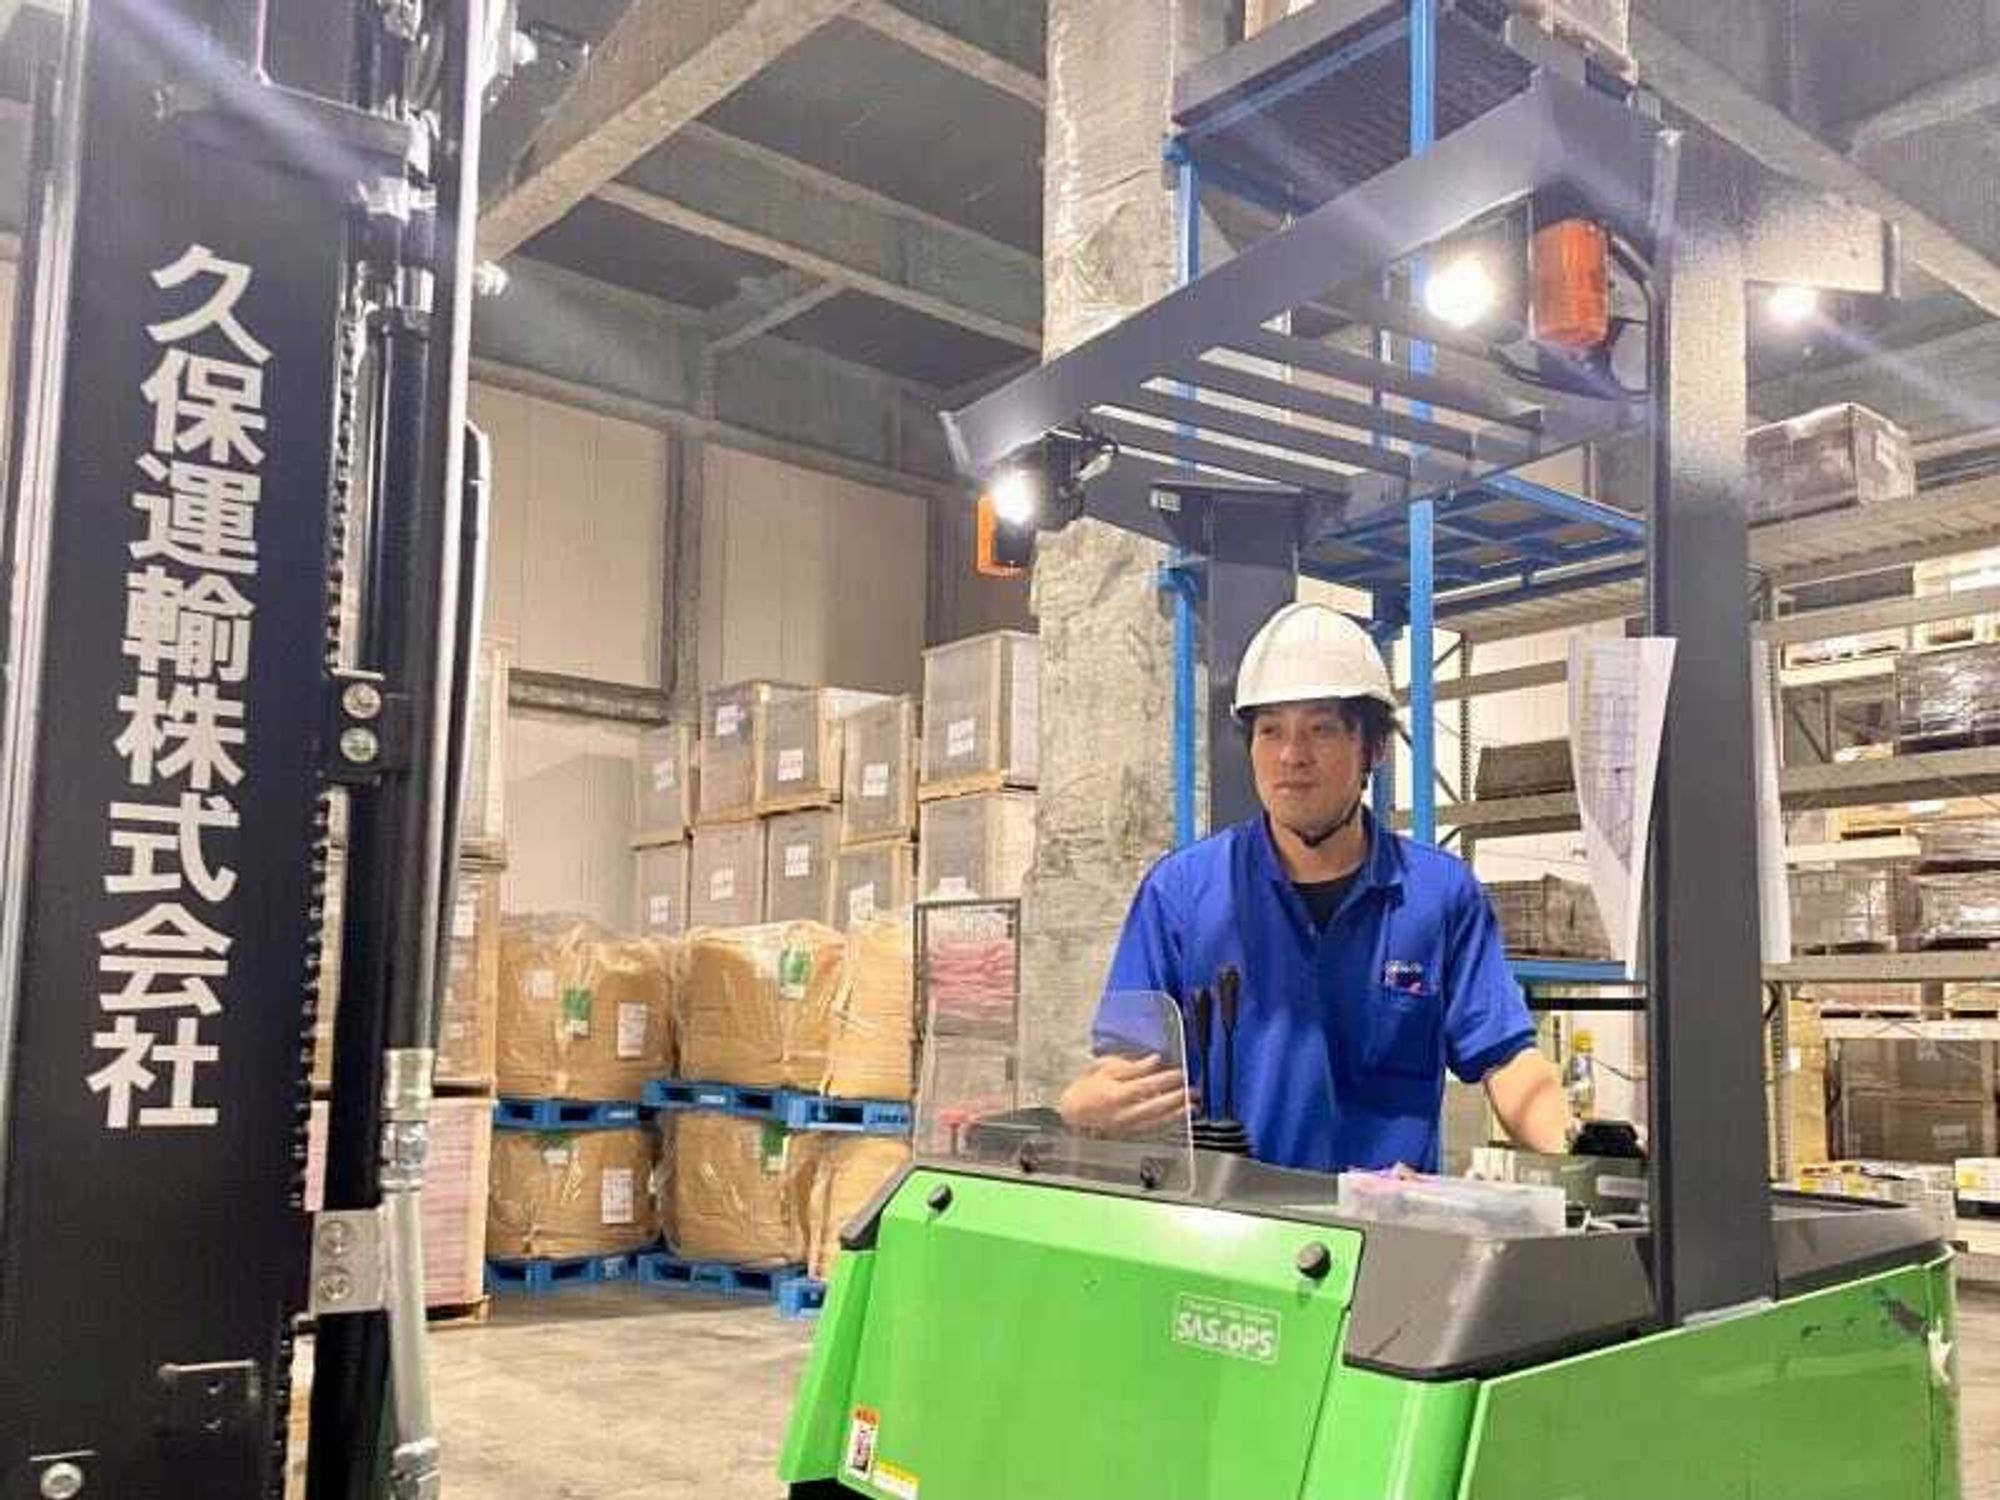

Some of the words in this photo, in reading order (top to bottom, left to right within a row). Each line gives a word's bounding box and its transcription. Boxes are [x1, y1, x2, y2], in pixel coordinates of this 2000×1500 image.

[85, 243, 273, 1130] 久保運輸株式会社
